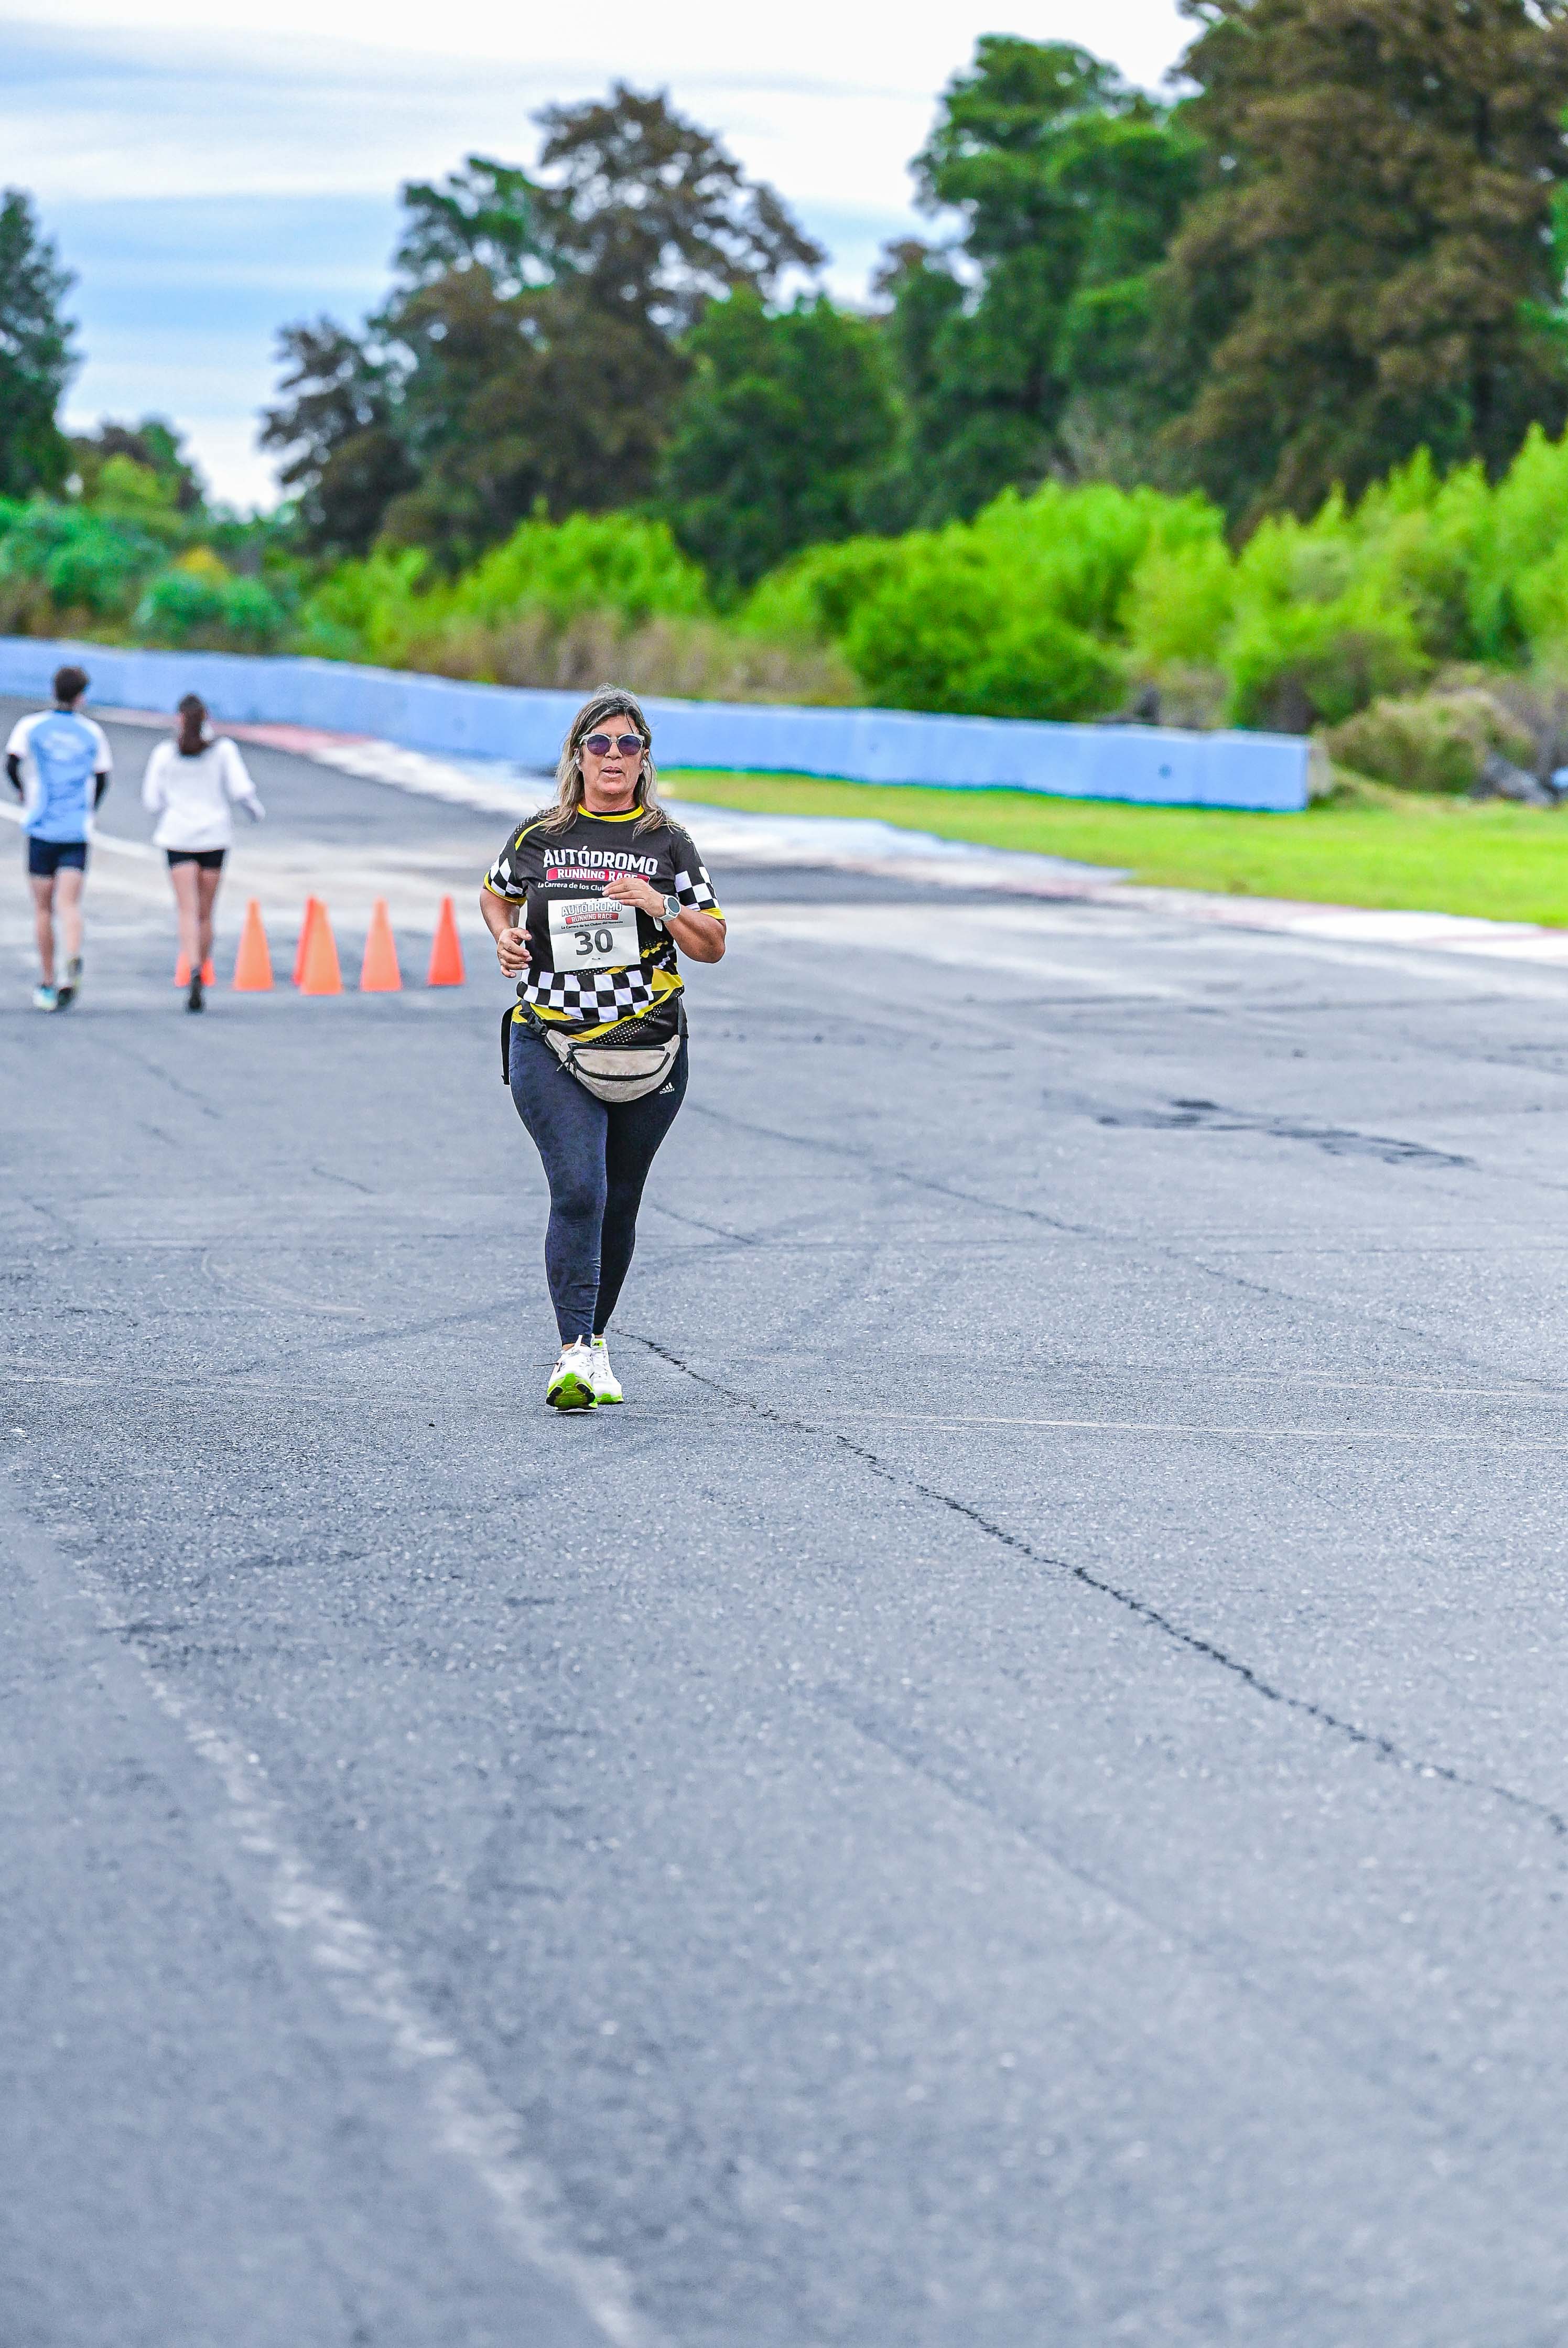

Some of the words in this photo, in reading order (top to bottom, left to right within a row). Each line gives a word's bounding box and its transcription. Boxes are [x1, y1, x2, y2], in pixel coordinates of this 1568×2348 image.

[543, 846, 658, 875] AUTÓDROMO
[557, 868, 605, 879] RUNNING
[561, 902, 623, 917] AUTÓDROMO
[571, 913, 596, 923] RUNNING
[575, 929, 613, 955] 30
